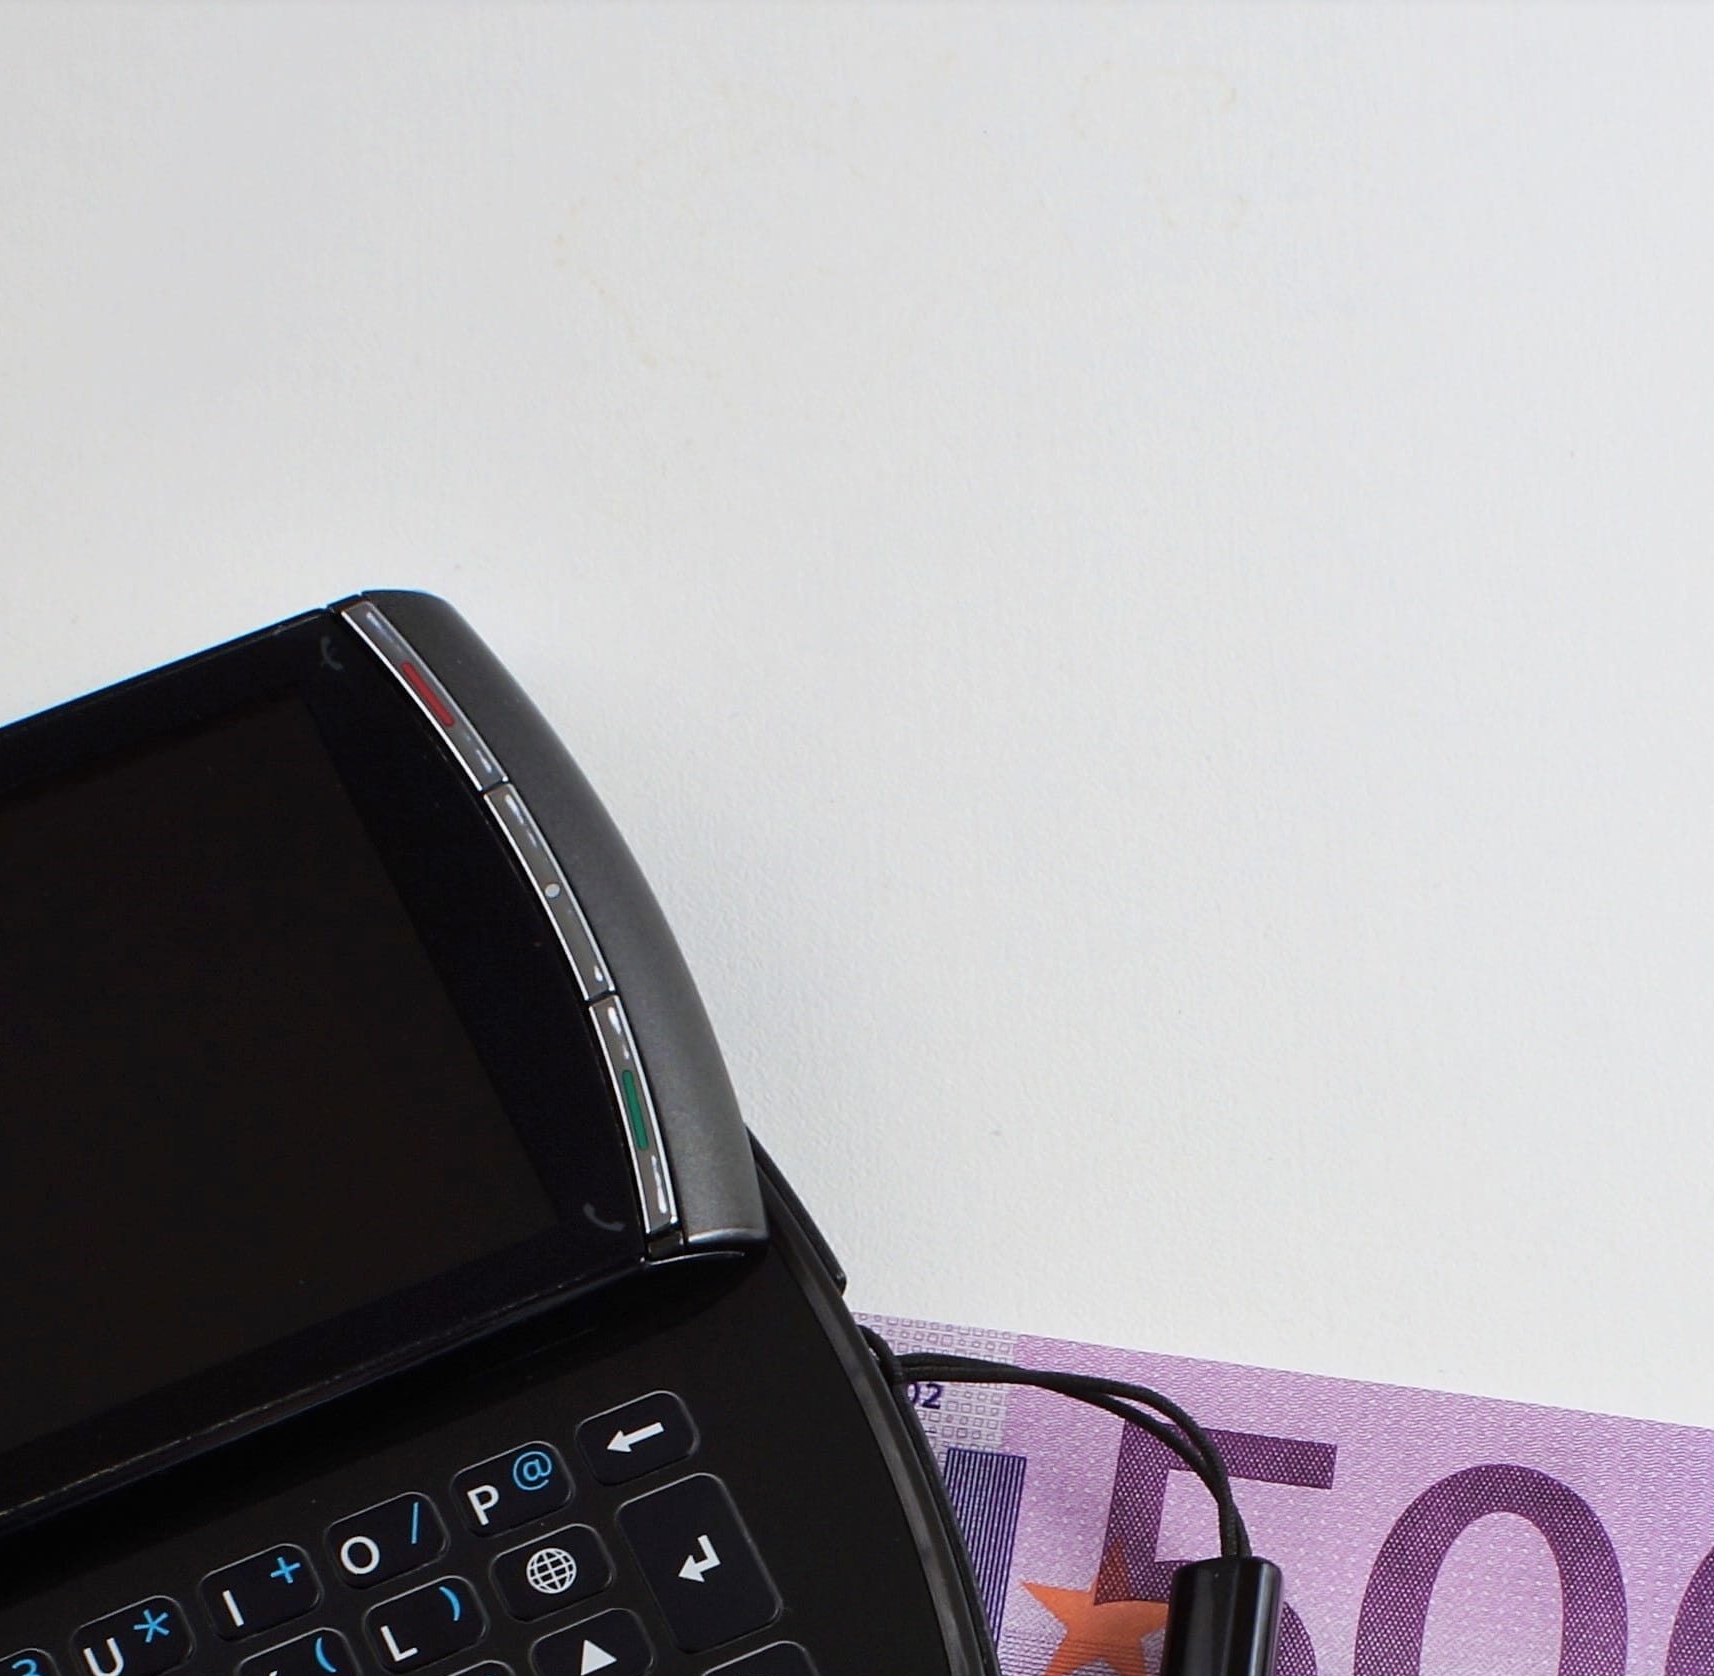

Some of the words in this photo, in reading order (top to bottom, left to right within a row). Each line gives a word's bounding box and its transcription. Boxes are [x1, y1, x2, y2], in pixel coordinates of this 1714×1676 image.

[467, 1484, 500, 1526] P
[510, 1448, 553, 1491] @
[340, 1535, 380, 1575] O
[222, 1589, 245, 1627] I
[270, 1556, 301, 1584] +
[380, 1625, 418, 1662] L
[439, 1586, 461, 1622] )
[315, 1637, 337, 1673] (
